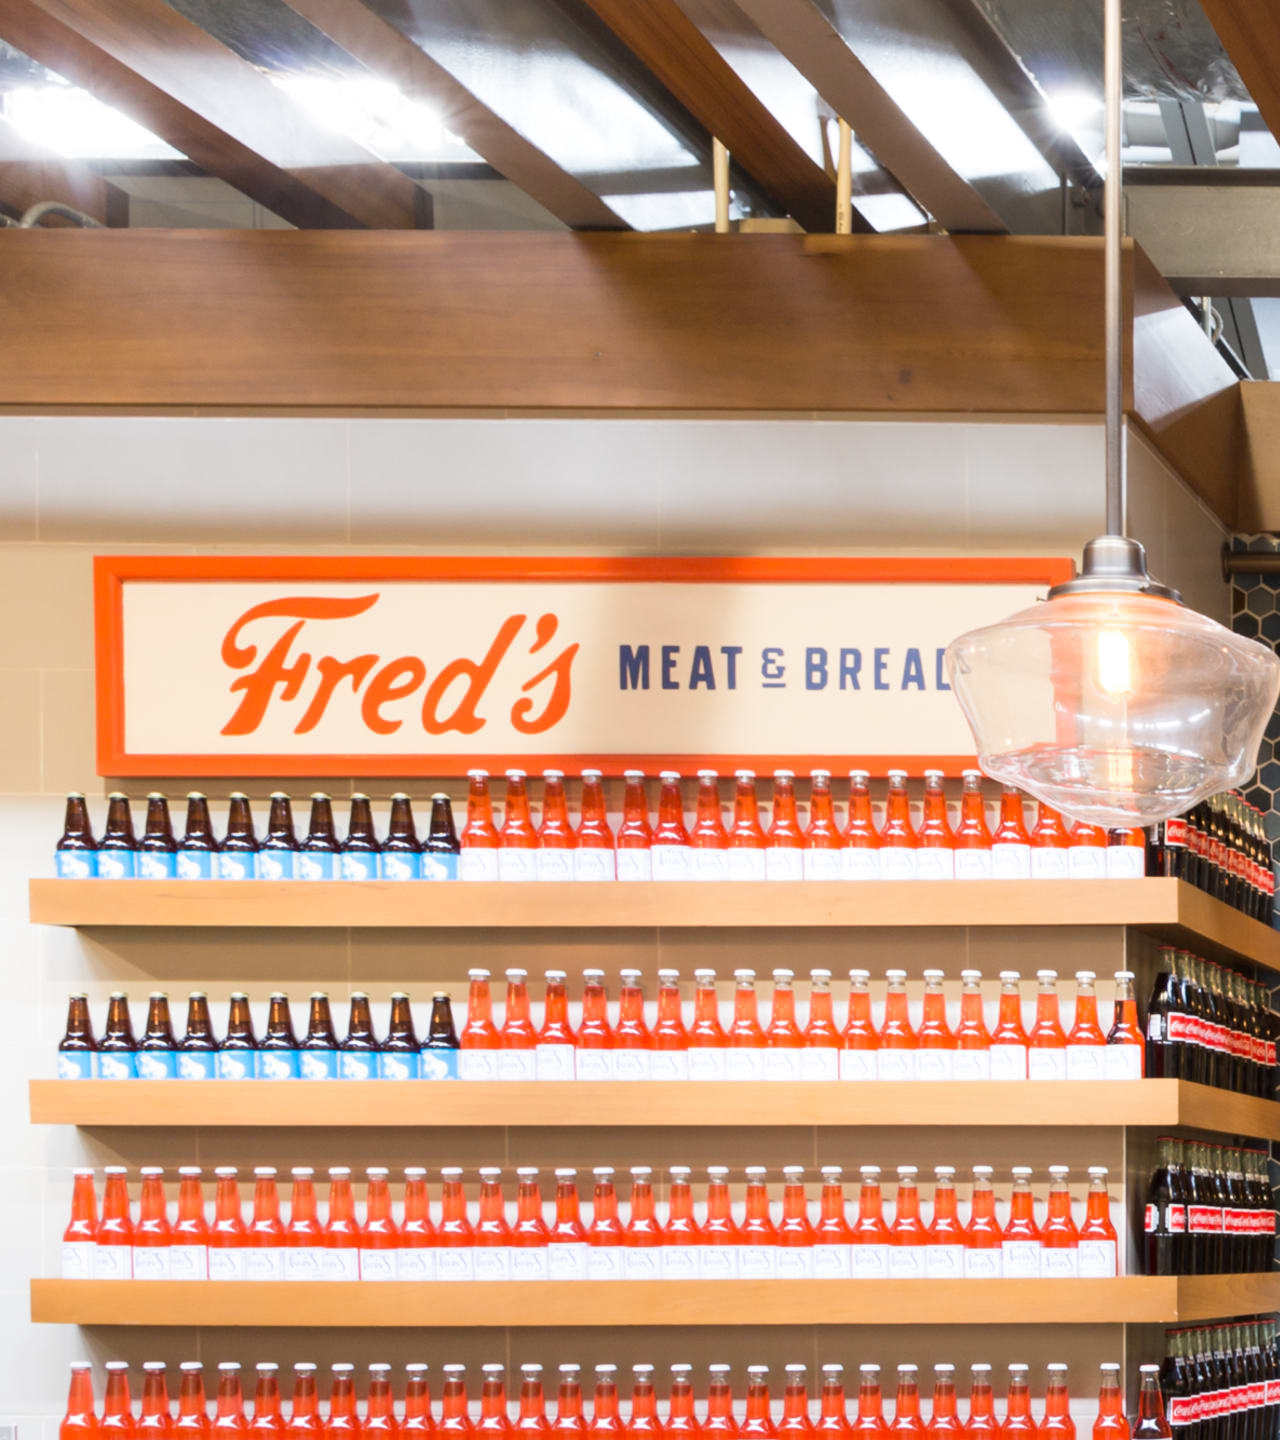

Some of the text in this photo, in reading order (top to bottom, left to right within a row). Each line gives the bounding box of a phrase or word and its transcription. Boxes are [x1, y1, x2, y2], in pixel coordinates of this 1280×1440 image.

[219, 592, 580, 737] Fred's
[619, 645, 743, 692] MEAT
[760, 648, 788, 688] &
